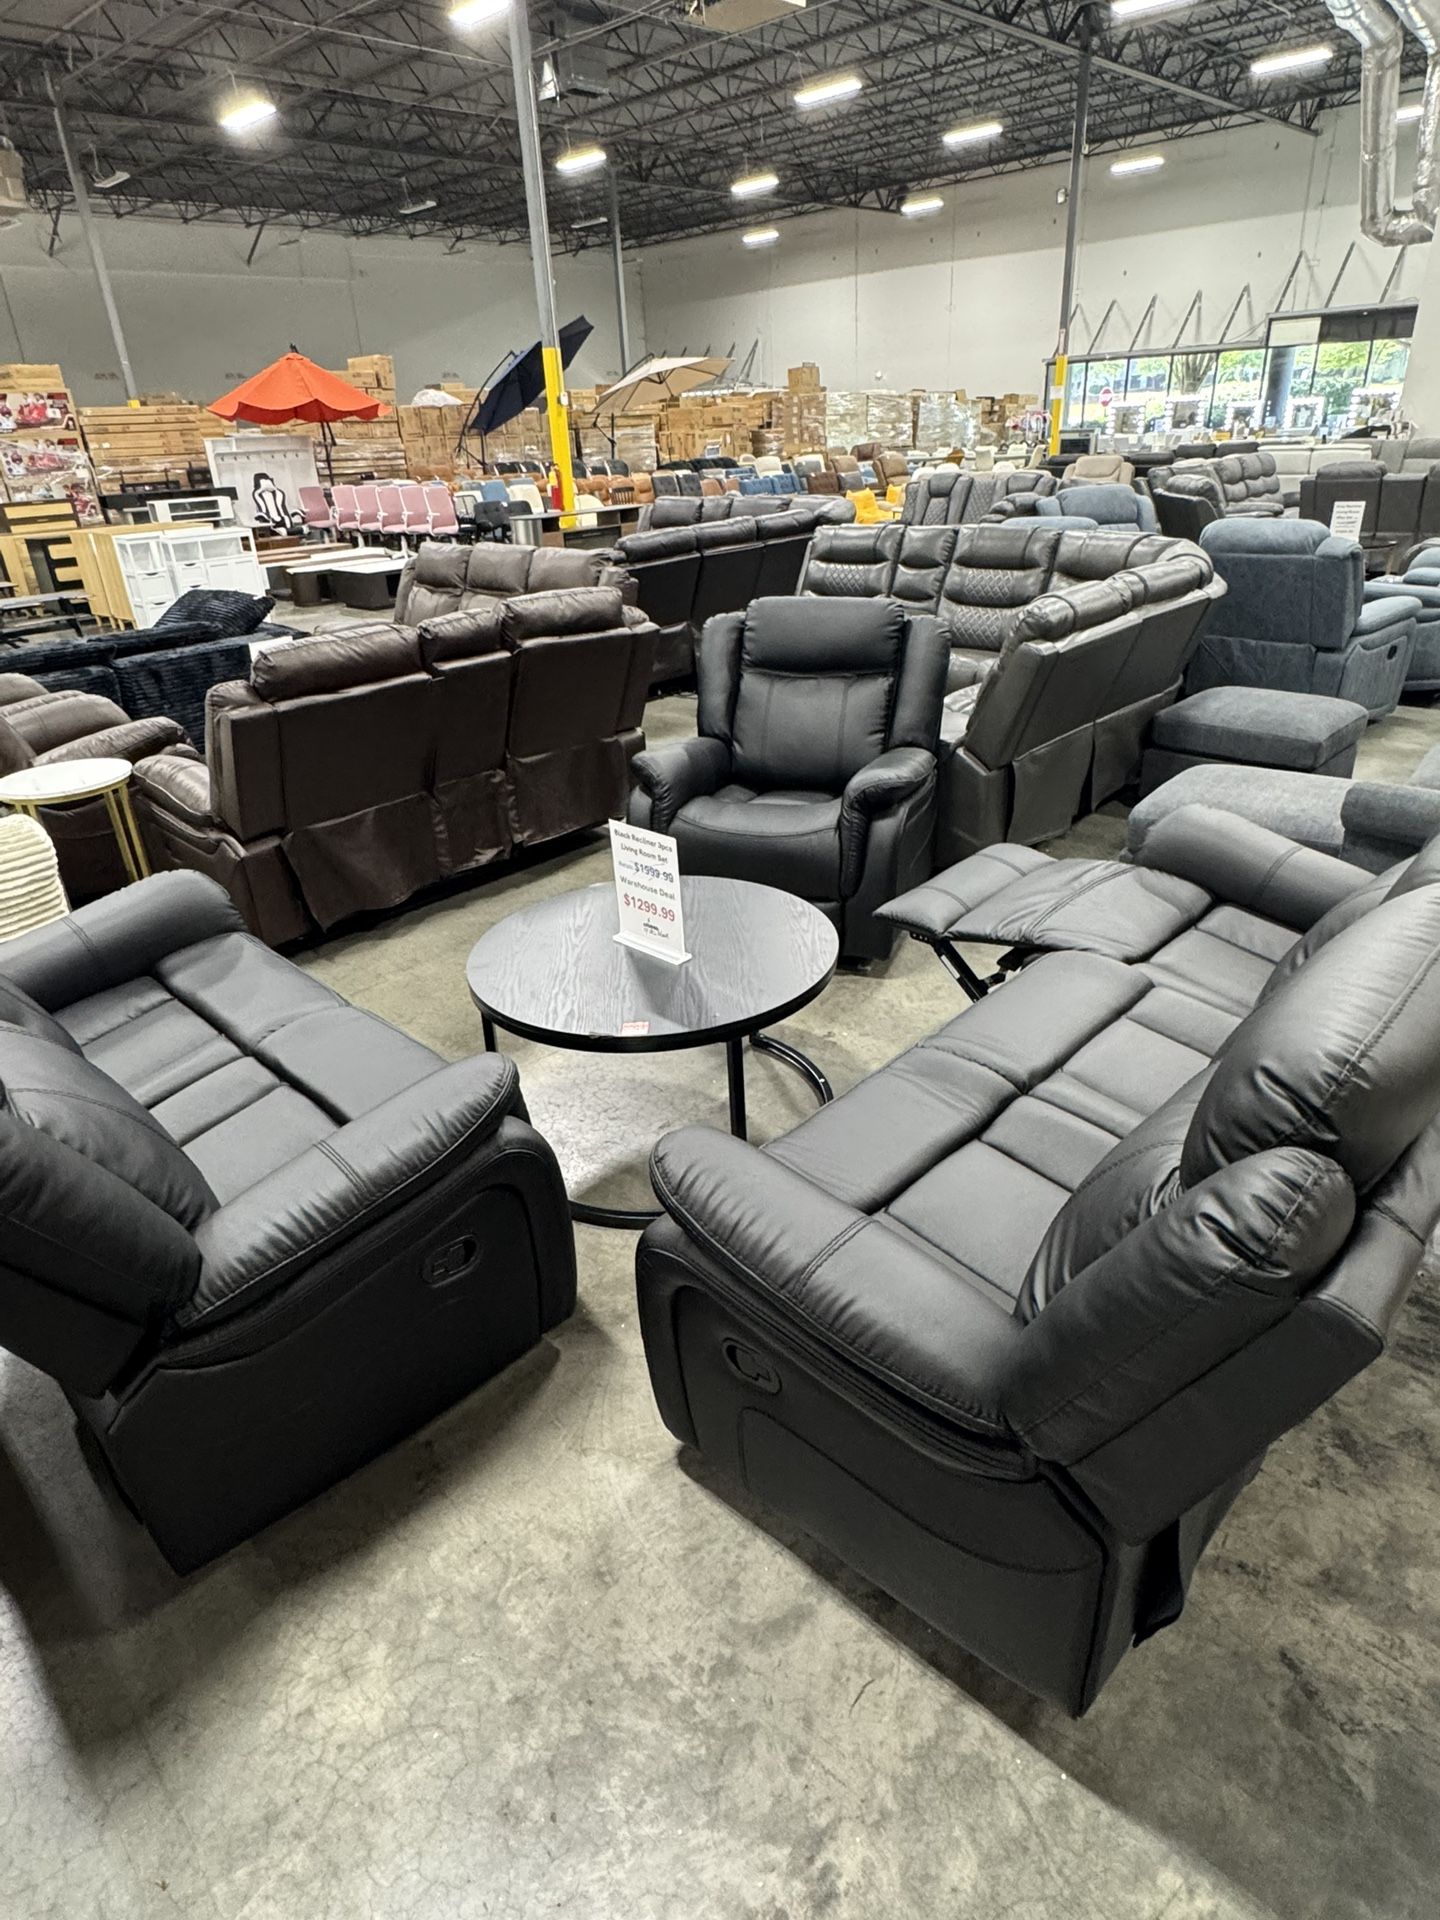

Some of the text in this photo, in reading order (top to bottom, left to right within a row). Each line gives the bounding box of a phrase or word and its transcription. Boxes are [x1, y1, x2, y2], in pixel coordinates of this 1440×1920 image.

[614, 829, 630, 840] Black
[631, 834, 656, 847] Recliner
[620, 843, 668, 863] Living Room Set
[619, 875, 675, 900] Warehouse Deal
[624, 893, 675, 922] $1299.99
